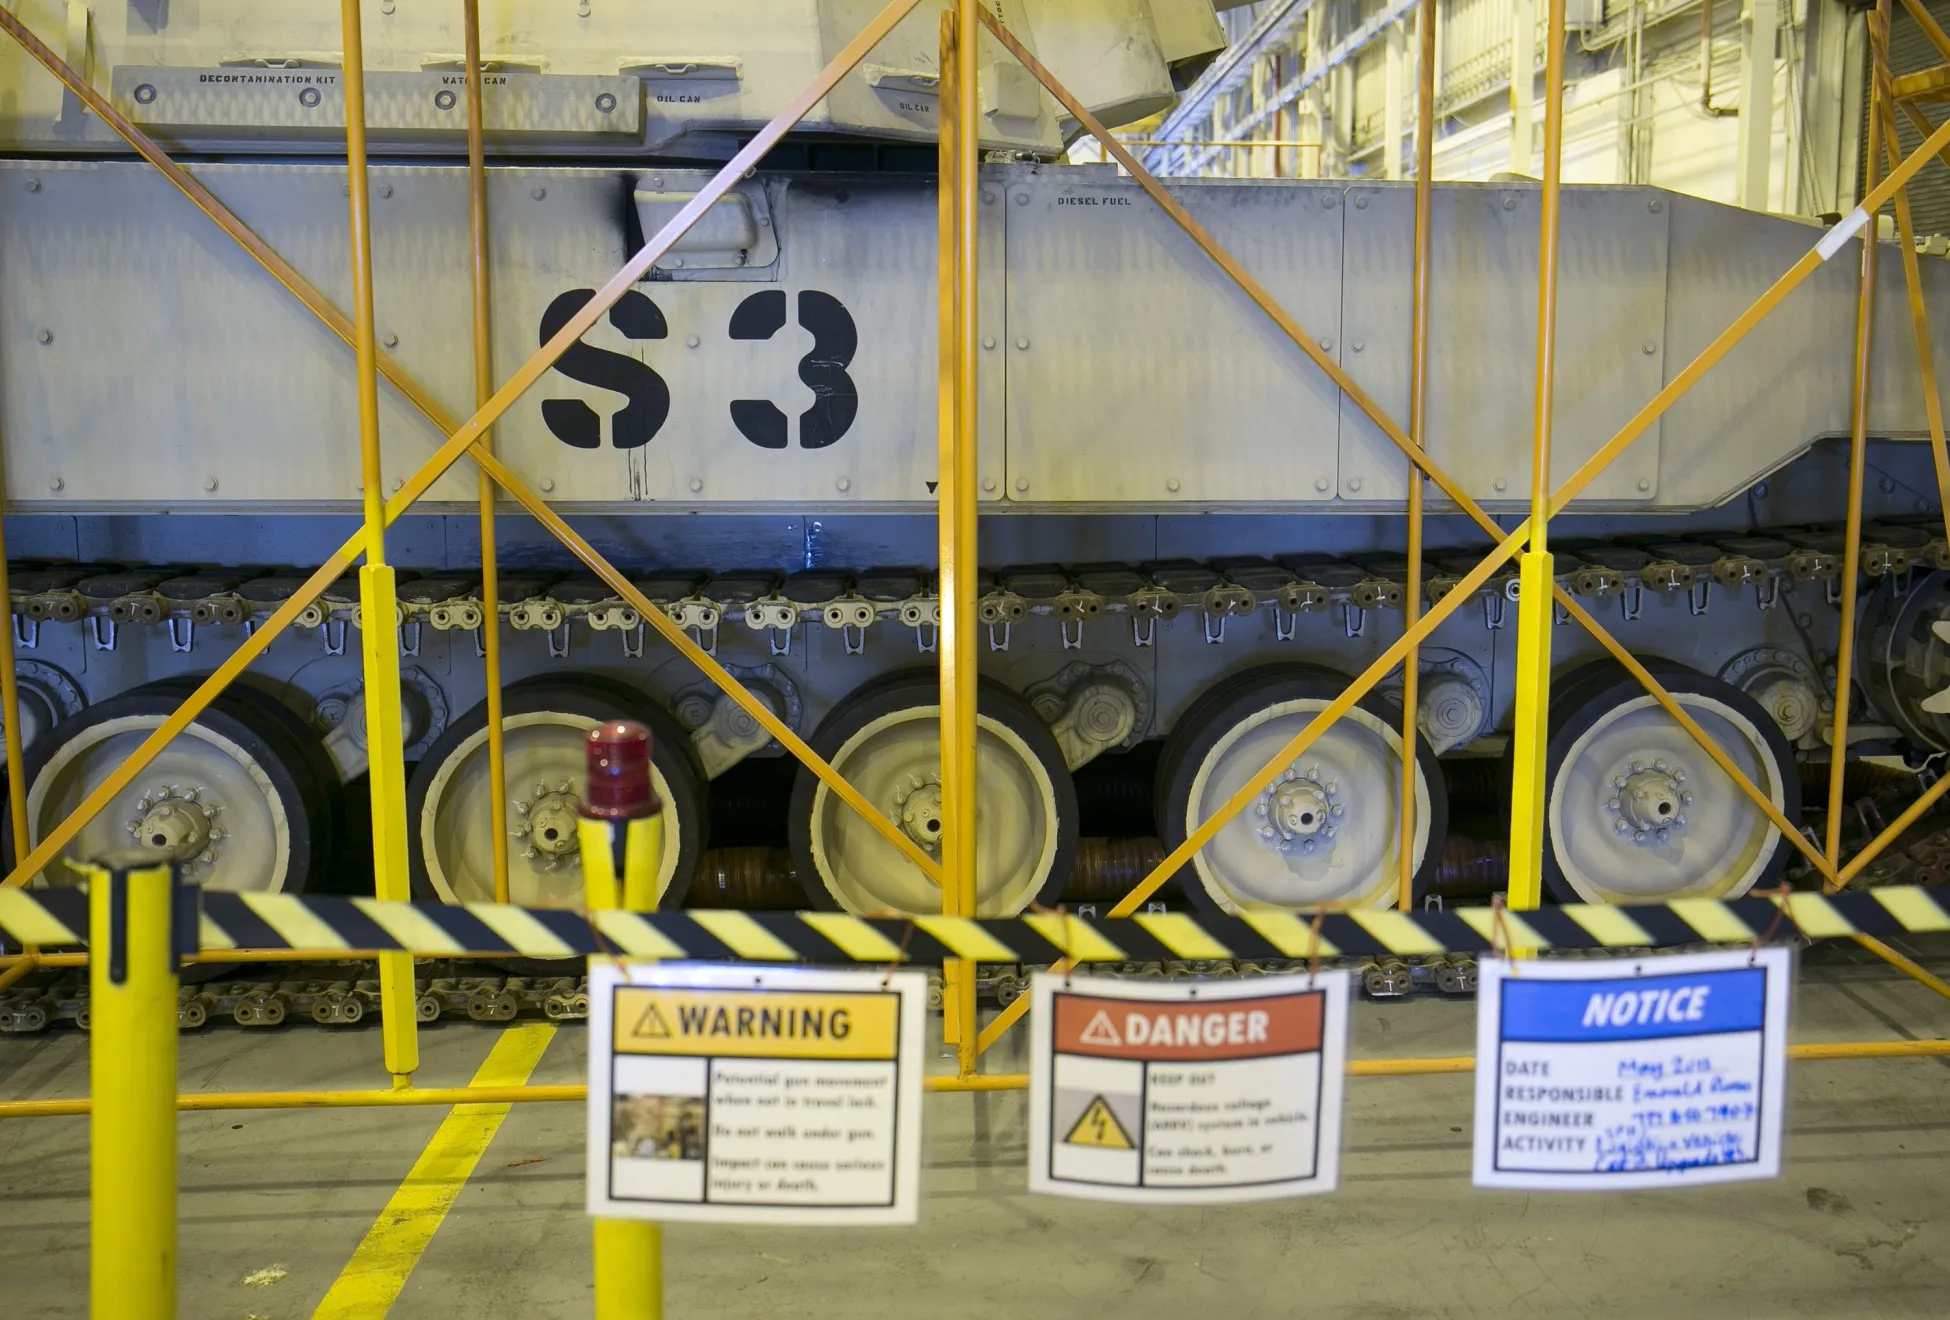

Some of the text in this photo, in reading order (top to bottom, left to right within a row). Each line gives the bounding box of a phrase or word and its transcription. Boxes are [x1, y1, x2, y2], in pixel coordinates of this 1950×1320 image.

[199, 74, 336, 85] DECONTAMINATION KIT
[442, 76, 507, 85] WAT CAN
[656, 95, 701, 103] OIL CAN
[899, 102, 930, 113] OIL CAN
[1057, 197, 1132, 206] DIESEL FUEL
[1580, 985, 1711, 1028] NOTICE
[679, 1005, 852, 1041] WARNING
[1124, 1009, 1270, 1047] DANGER
[1505, 1060, 1550, 1078] DATE
[1504, 1083, 1624, 1102] RESPONSIBLE
[1503, 1110, 1594, 1128] ENGINEER
[1502, 1134, 1586, 1152] ACTIVITY
